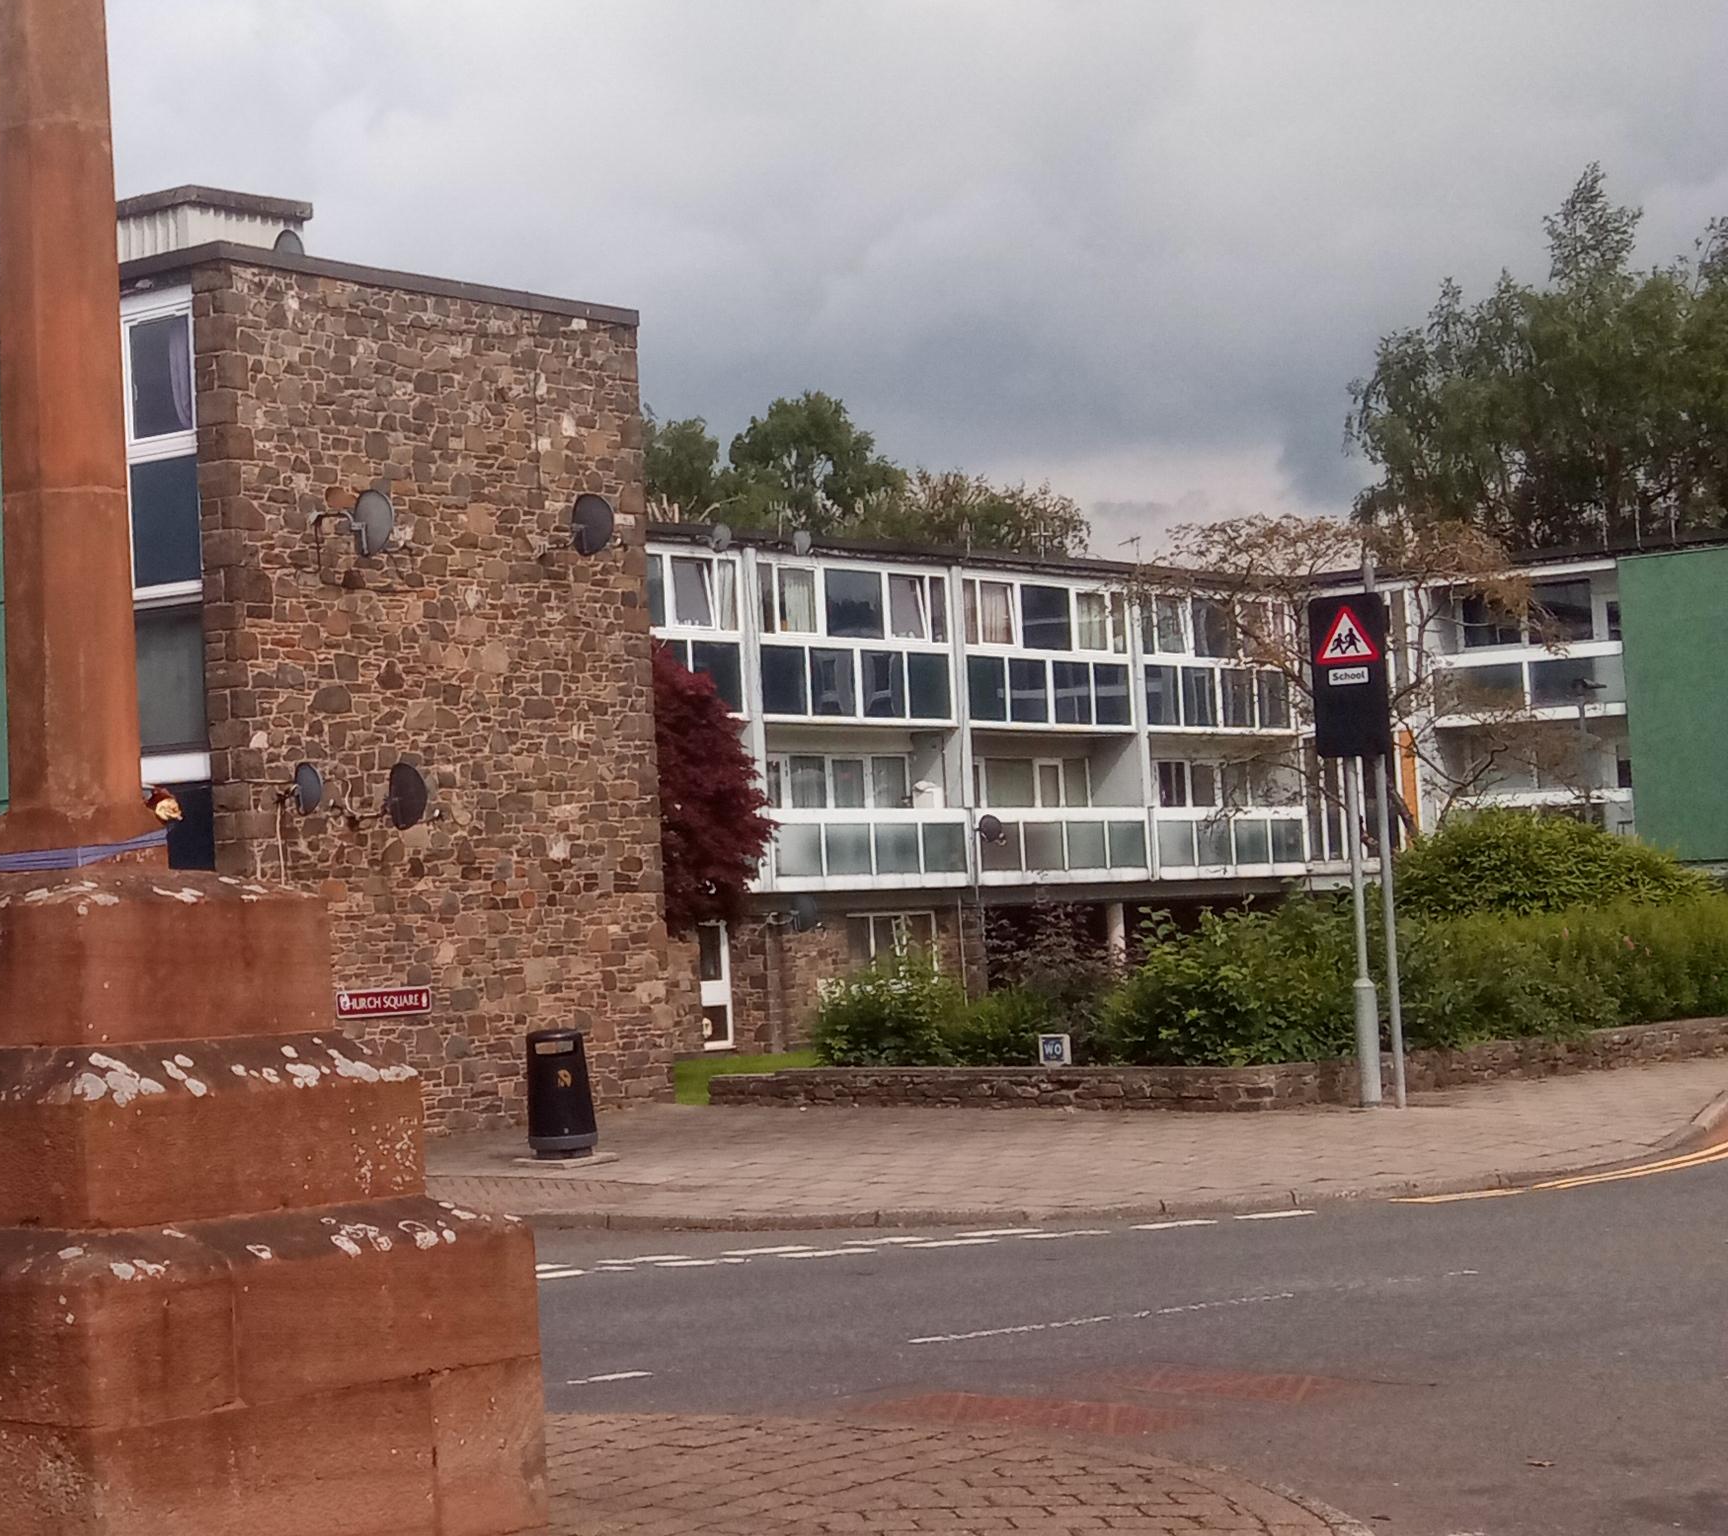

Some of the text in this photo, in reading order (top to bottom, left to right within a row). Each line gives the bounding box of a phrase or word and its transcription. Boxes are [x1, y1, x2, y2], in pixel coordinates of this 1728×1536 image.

[1332, 670, 1365, 681] School
[341, 994, 420, 1011] CHURCH SQUARE
